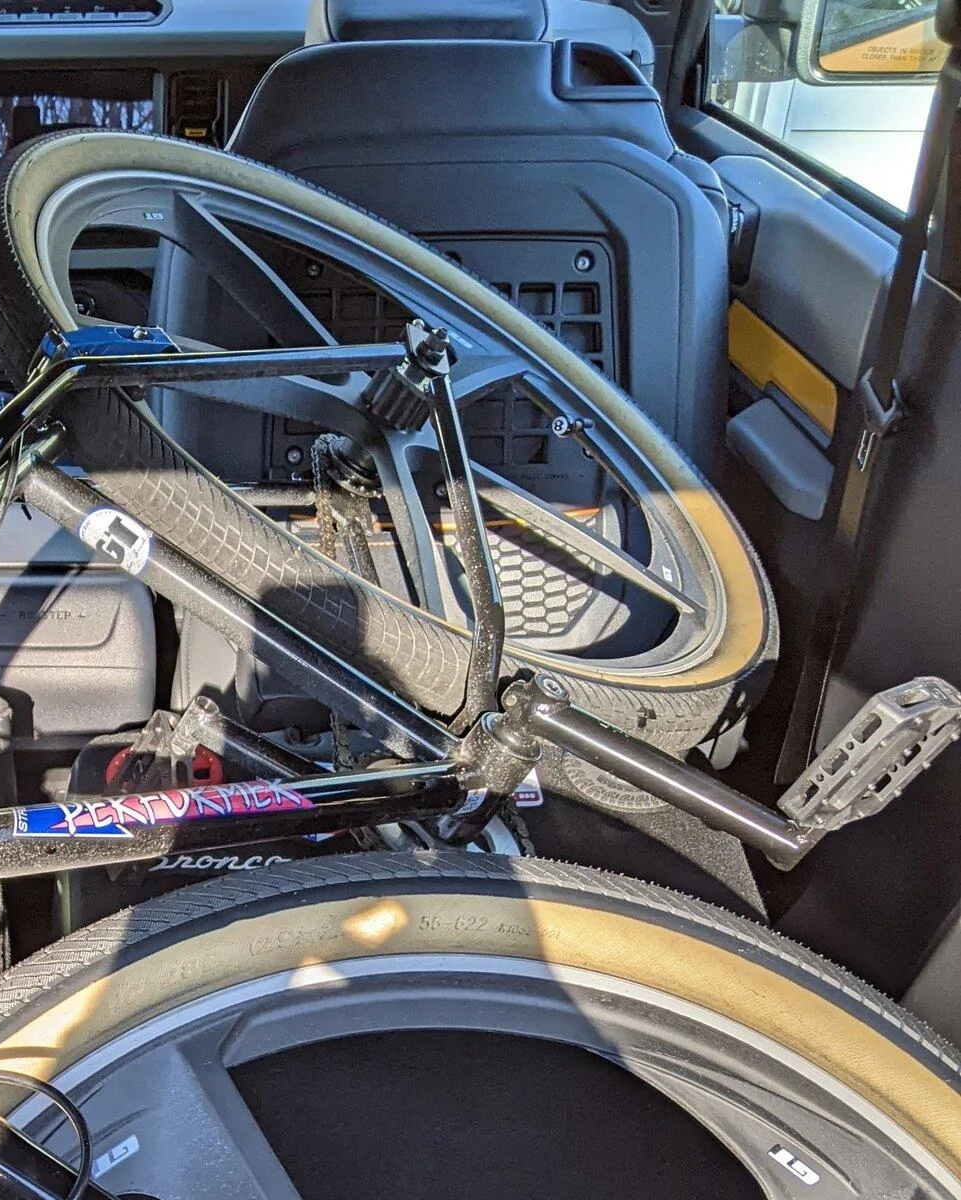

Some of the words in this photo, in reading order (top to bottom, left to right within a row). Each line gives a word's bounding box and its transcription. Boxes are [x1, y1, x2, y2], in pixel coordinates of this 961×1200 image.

[867, 46, 897, 54] OBJECTS
[91, 1134, 139, 1180] GT
[767, 1144, 819, 1185] GT
